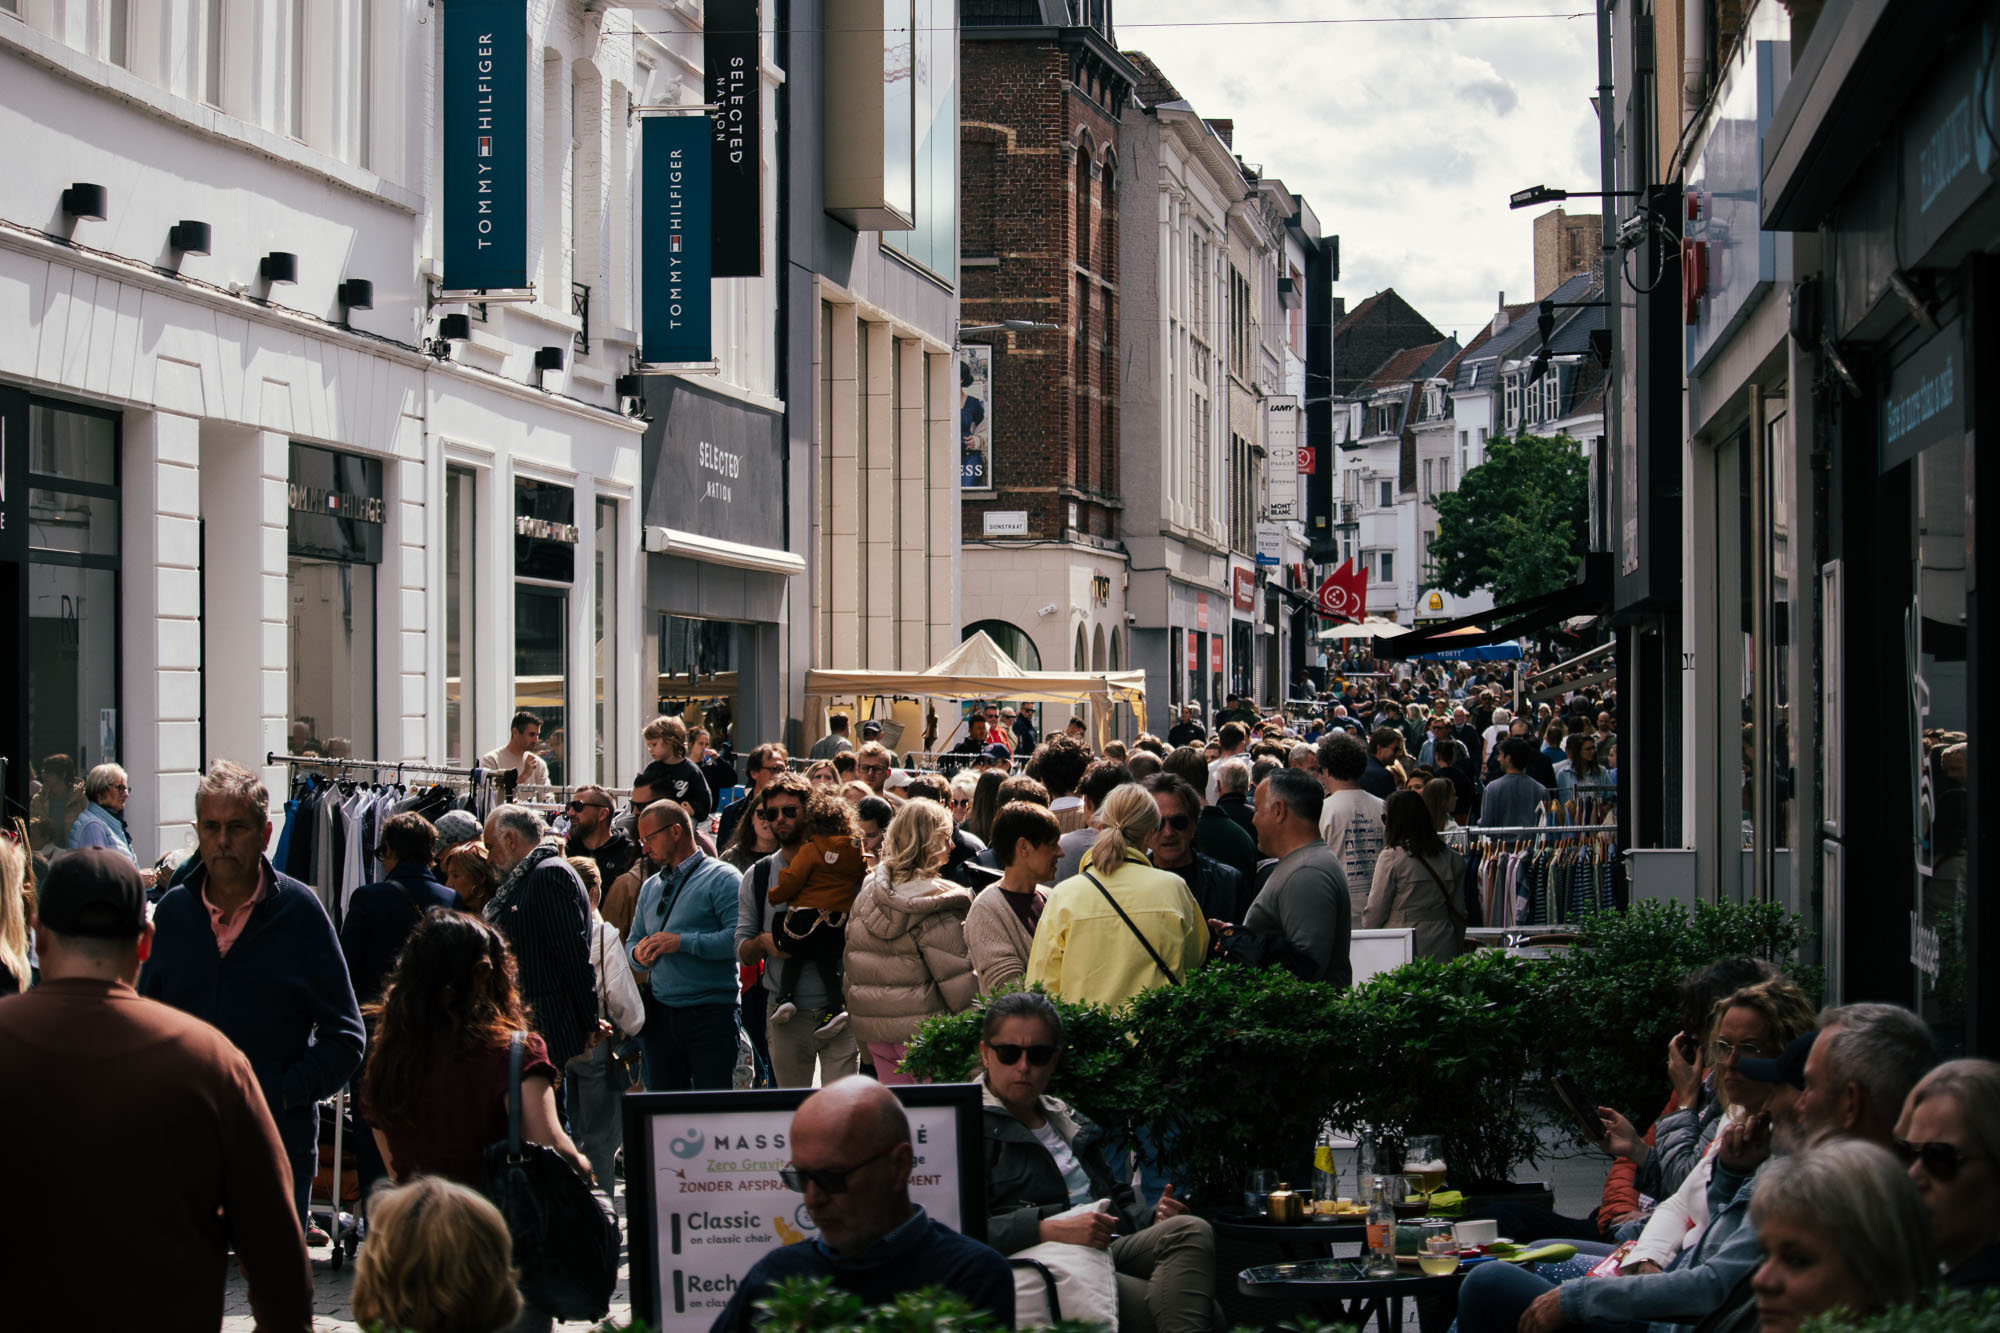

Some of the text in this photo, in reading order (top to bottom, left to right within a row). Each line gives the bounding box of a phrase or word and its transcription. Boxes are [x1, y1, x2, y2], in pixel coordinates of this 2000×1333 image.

[716, 77, 726, 141] NATION
[729, 57, 744, 164] SELECTED
[478, 33, 492, 250] TOMMY HILFIGER
[670, 149, 682, 329] TOMMY HILFIGER
[1270, 404, 1295, 412] LAMY
[699, 440, 740, 479] SELECTED
[288, 483, 329, 516] OMMY
[706, 480, 732, 503] NATION
[714, 1134, 786, 1150] MASS
[706, 1159, 737, 1171] Zero
[911, 1155, 926, 1168] ge
[679, 1174, 942, 1193] ZONDER AFSPRA MENT
[687, 1210, 761, 1230] Classic
[690, 1233, 773, 1245] on classic chair
[687, 1273, 738, 1293] Rech
[689, 1298, 728, 1308] on clas
